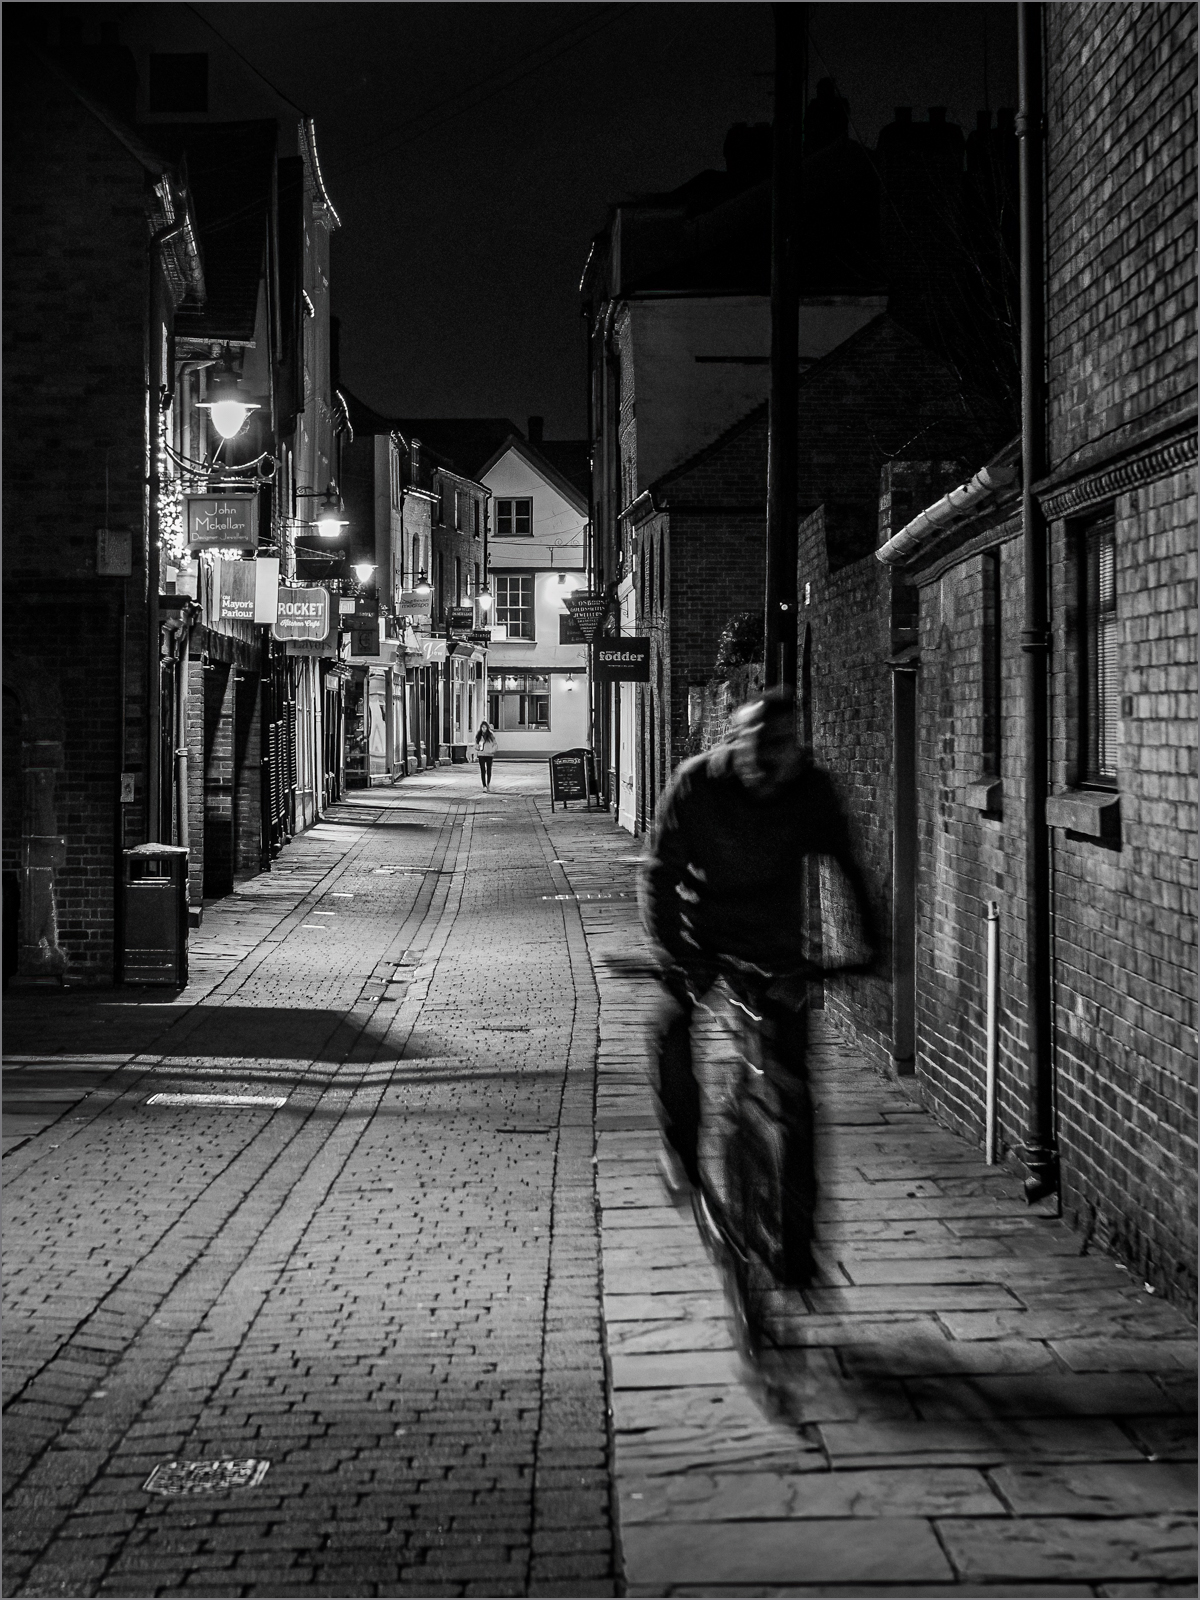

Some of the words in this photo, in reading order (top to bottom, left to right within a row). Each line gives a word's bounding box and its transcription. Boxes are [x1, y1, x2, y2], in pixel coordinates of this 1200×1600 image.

[204, 502, 236, 516] John
[191, 533, 218, 541] Designer
[222, 600, 253, 609] Mayor's
[278, 602, 324, 616] ROCKET
[221, 609, 253, 618] Parlour
[280, 619, 304, 628] Kitchen
[291, 641, 332, 651] Layers
